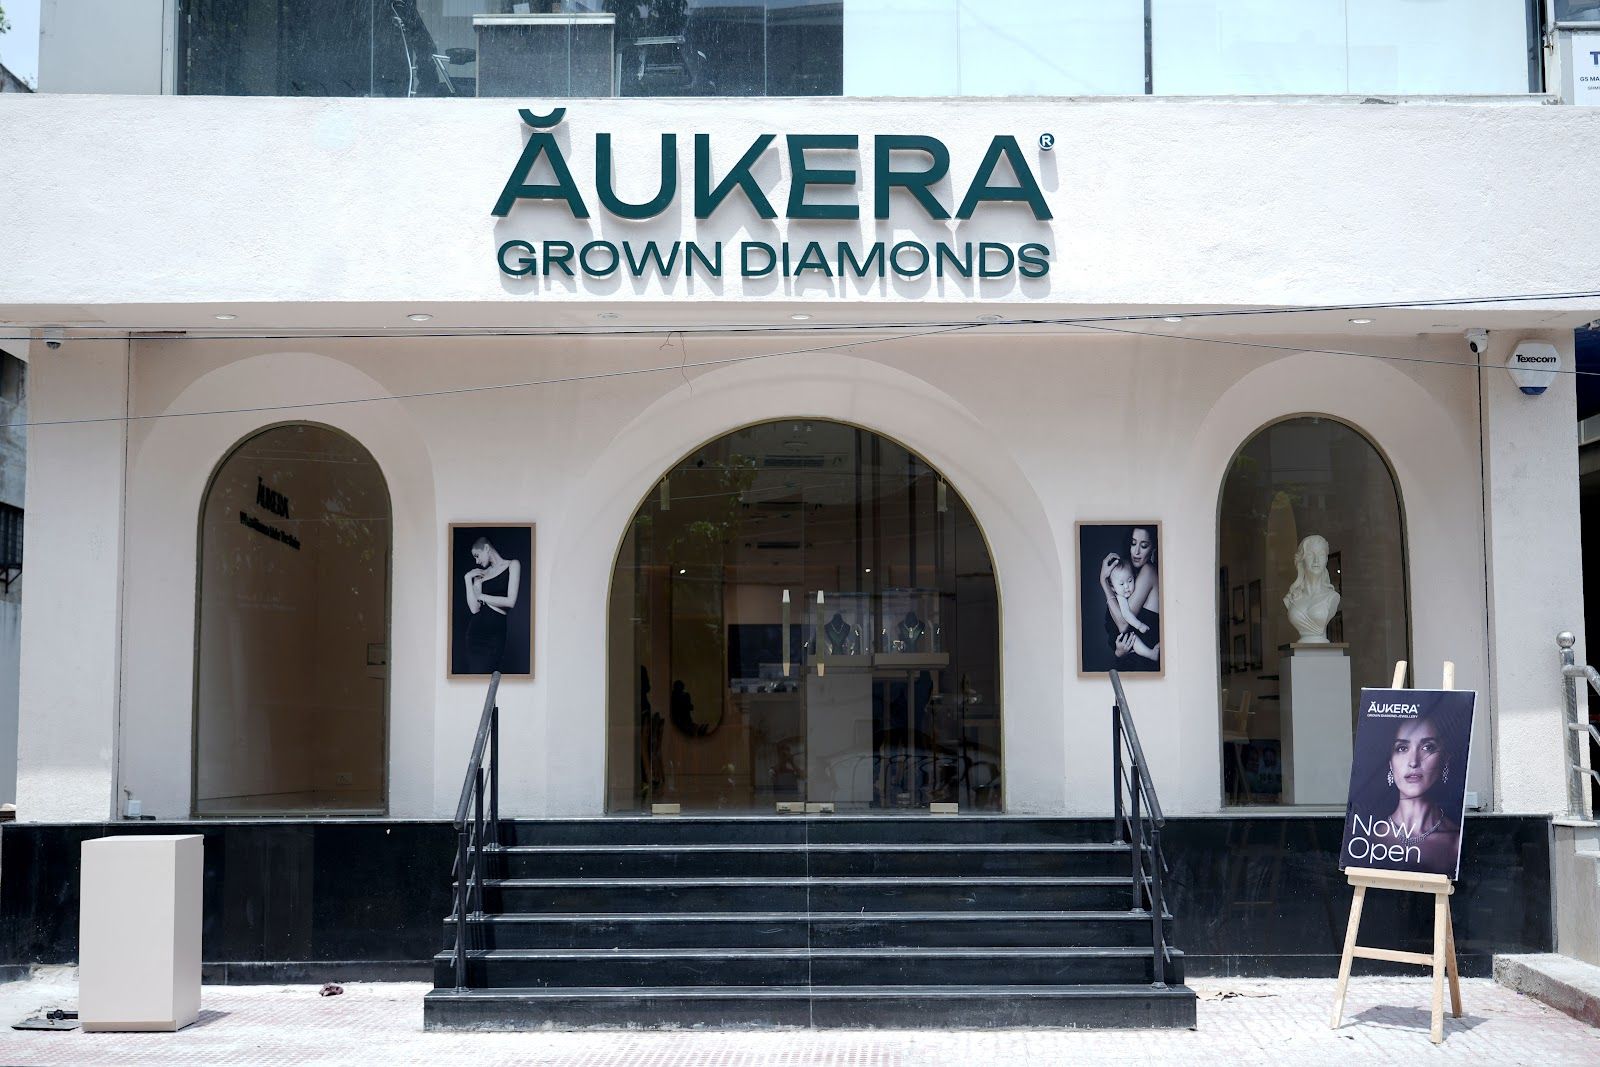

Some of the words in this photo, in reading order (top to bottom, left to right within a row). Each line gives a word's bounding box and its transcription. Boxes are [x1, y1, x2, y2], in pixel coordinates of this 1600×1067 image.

[497, 239, 722, 277] GROWN
[741, 241, 1050, 278] DIAMONDS
[1516, 354, 1557, 363] Texecom
[1352, 813, 1417, 839] Now
[1348, 837, 1421, 864] Open
